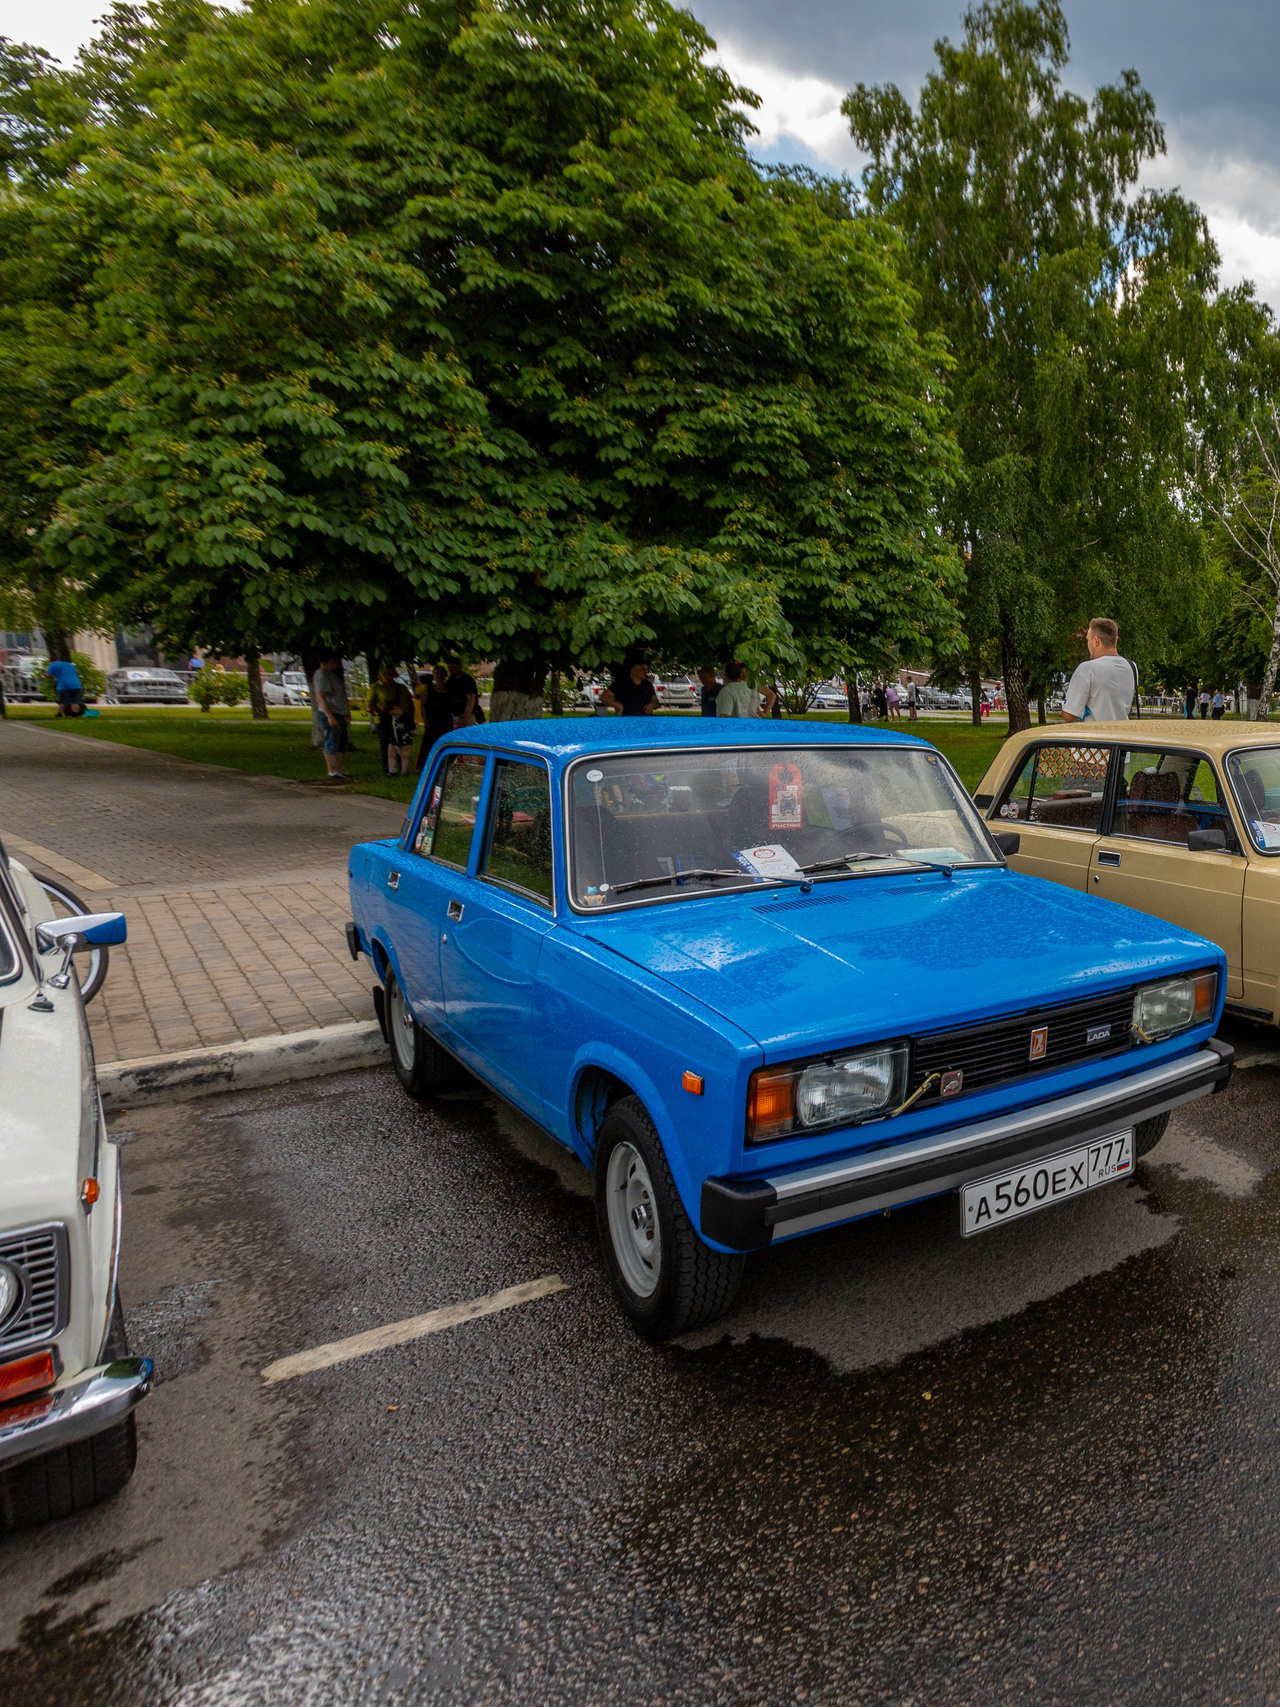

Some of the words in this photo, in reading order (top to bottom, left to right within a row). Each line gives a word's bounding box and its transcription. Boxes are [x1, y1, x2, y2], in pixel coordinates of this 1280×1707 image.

[1087, 1030, 1110, 1042] LADA
[1090, 1138, 1125, 1172] 777
[1098, 1164, 1116, 1178] RUS
